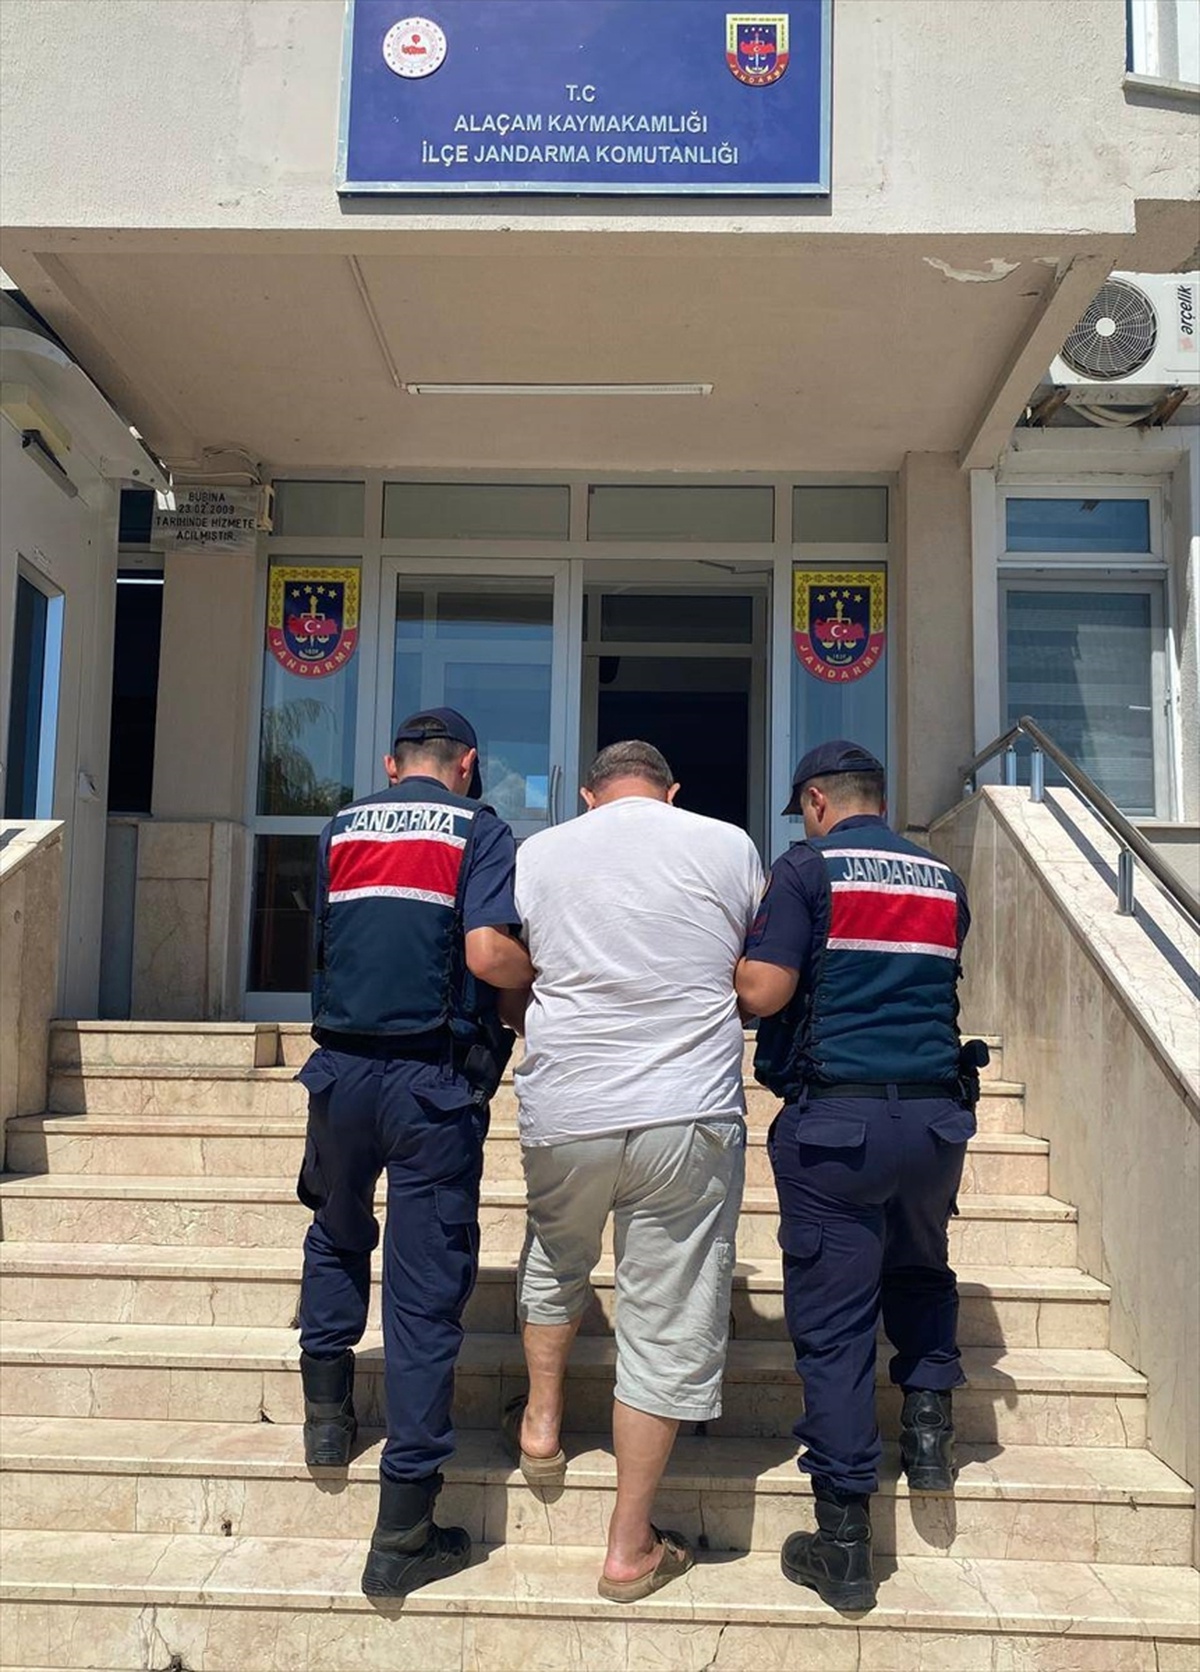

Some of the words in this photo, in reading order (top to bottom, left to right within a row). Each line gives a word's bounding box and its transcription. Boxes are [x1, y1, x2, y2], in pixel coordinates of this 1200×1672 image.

[566, 84, 596, 102] T.C
[454, 114, 542, 135] ALAÇAM
[548, 111, 708, 132] KAYMAKAMLIĞI
[422, 140, 468, 167] İLÇE
[473, 145, 590, 163] JANDARMA
[596, 142, 738, 164] KOMUTANLIĞI
[1177, 285, 1196, 335] arçelik
[273, 638, 352, 674] JANDARMA
[800, 645, 880, 679] JANDARMA
[345, 809, 455, 835] JANDARMA
[842, 857, 948, 889] JANDARMA
